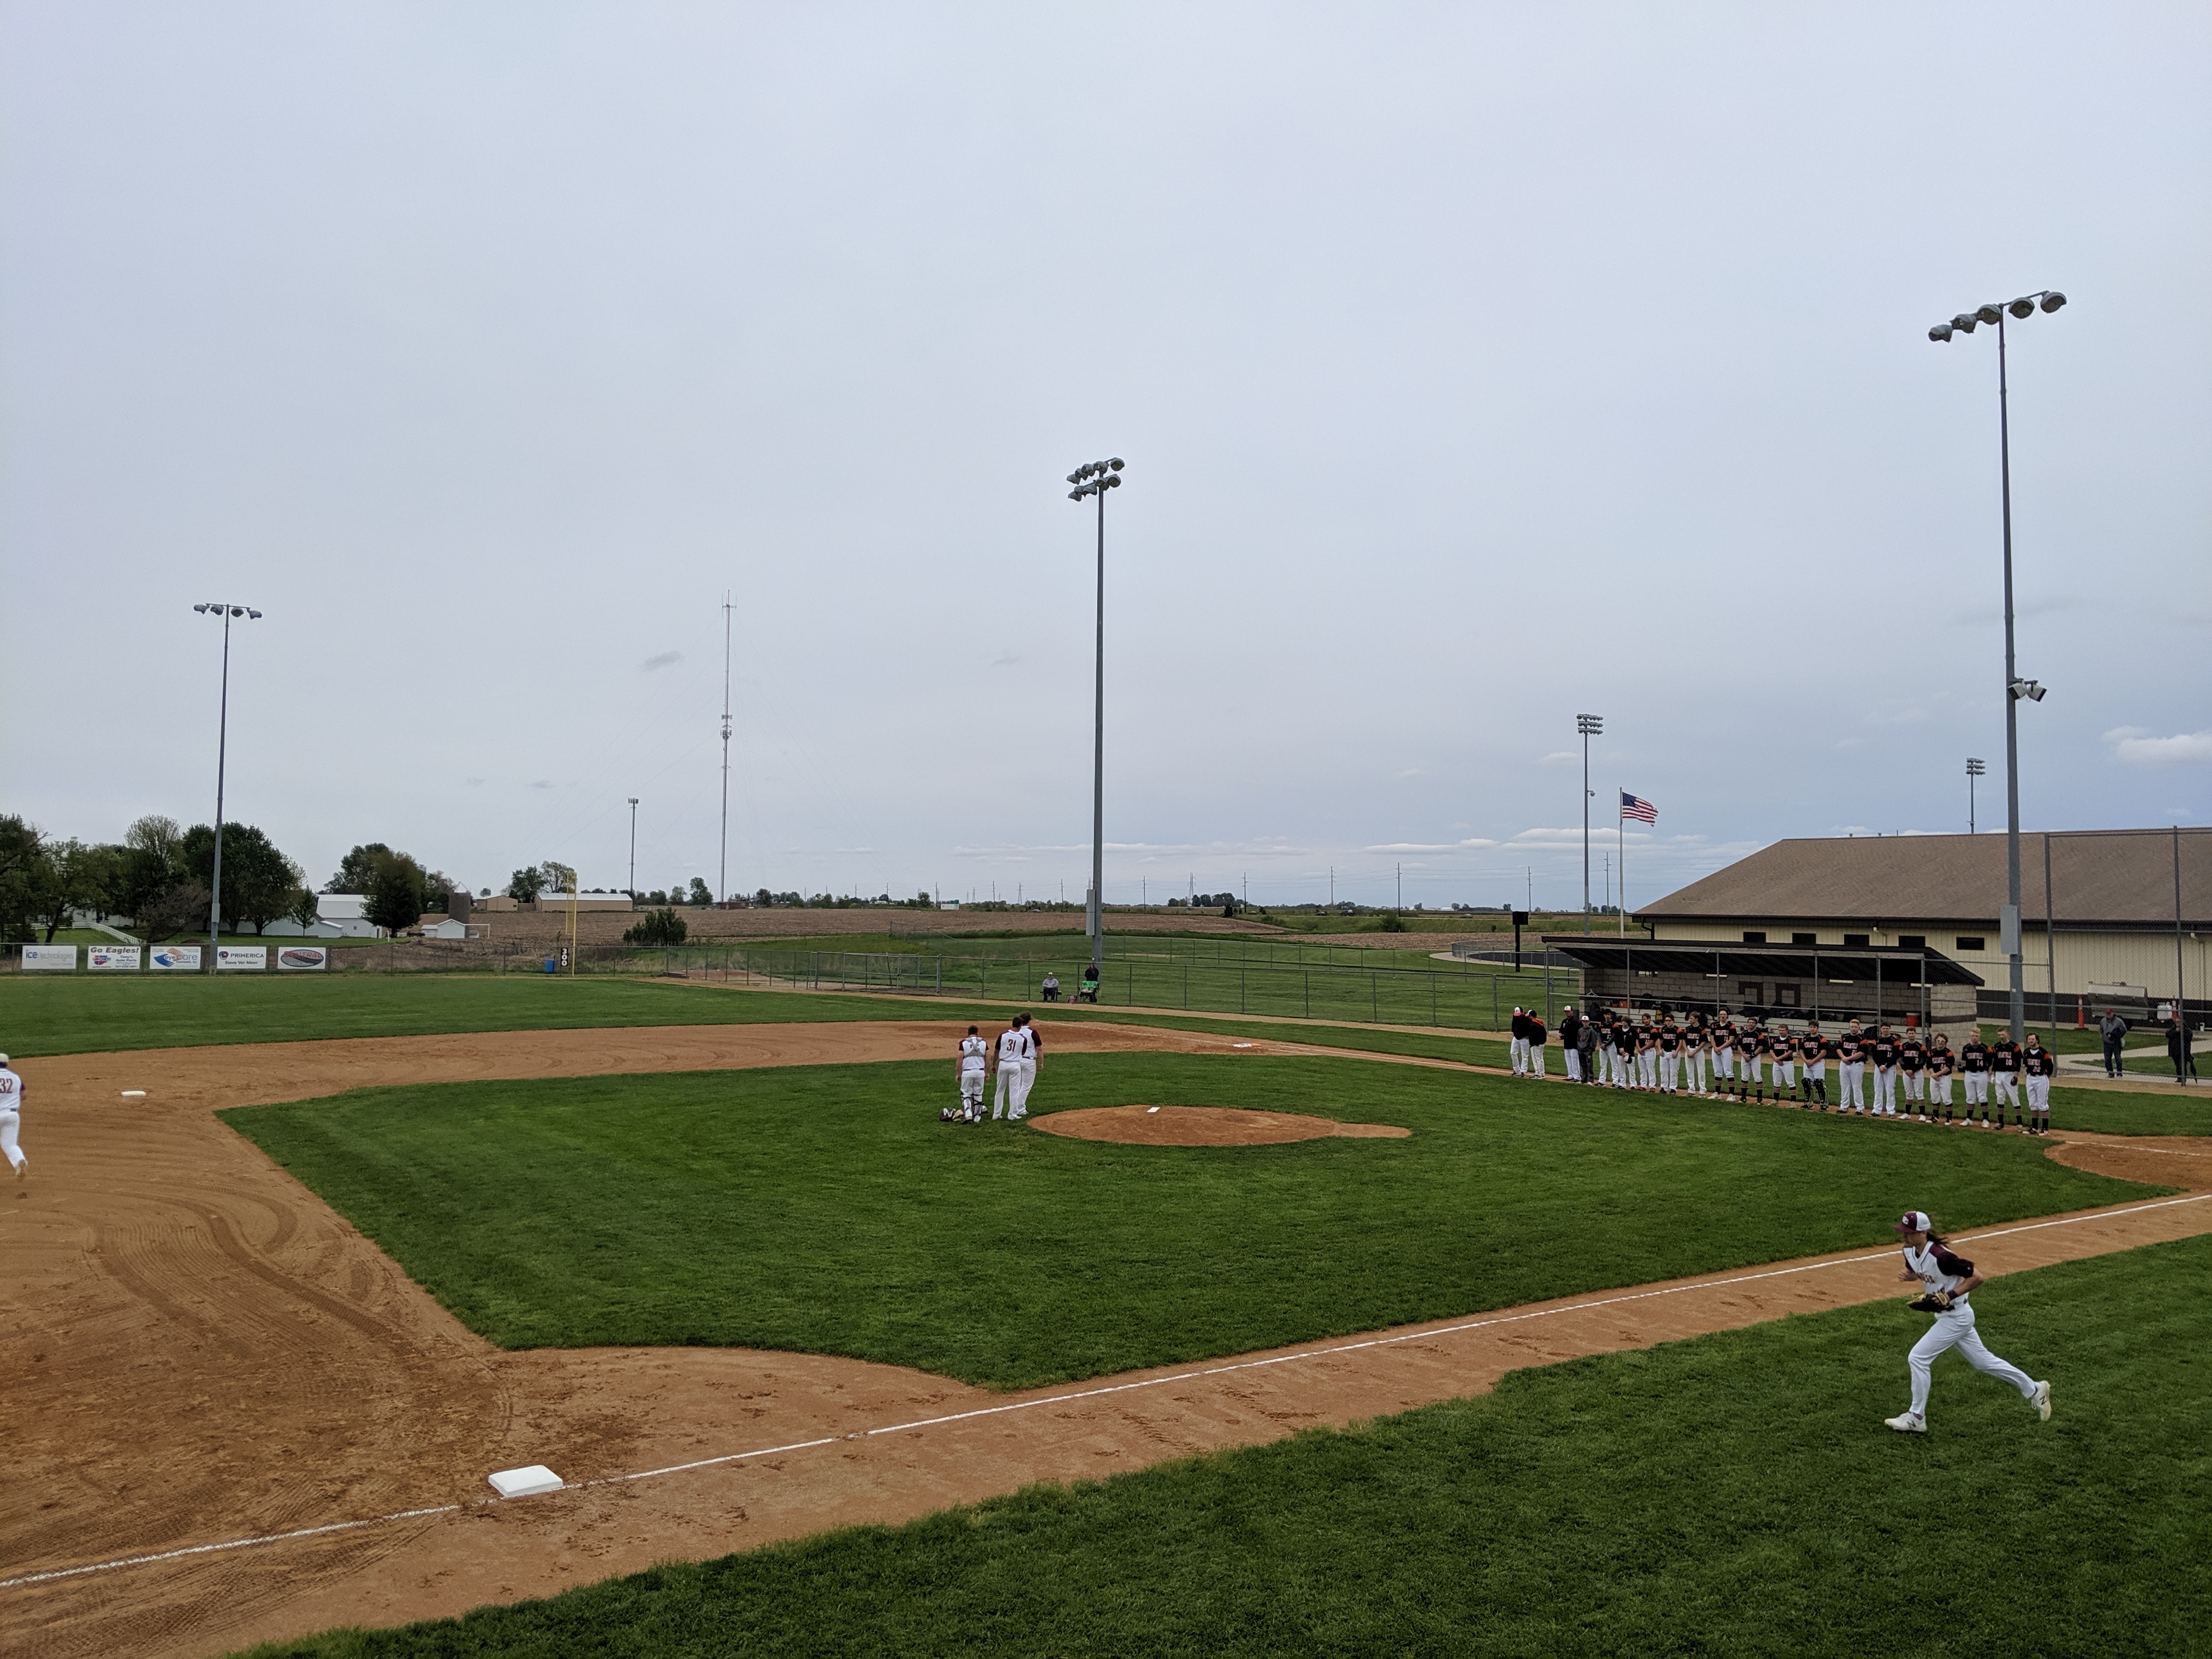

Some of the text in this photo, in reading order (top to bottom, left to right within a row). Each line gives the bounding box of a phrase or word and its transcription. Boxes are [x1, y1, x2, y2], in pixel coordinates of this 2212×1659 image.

[26, 949, 38, 958] ice
[1006, 1039, 1017, 1052] 31
[0, 1078, 13, 1093] 32
